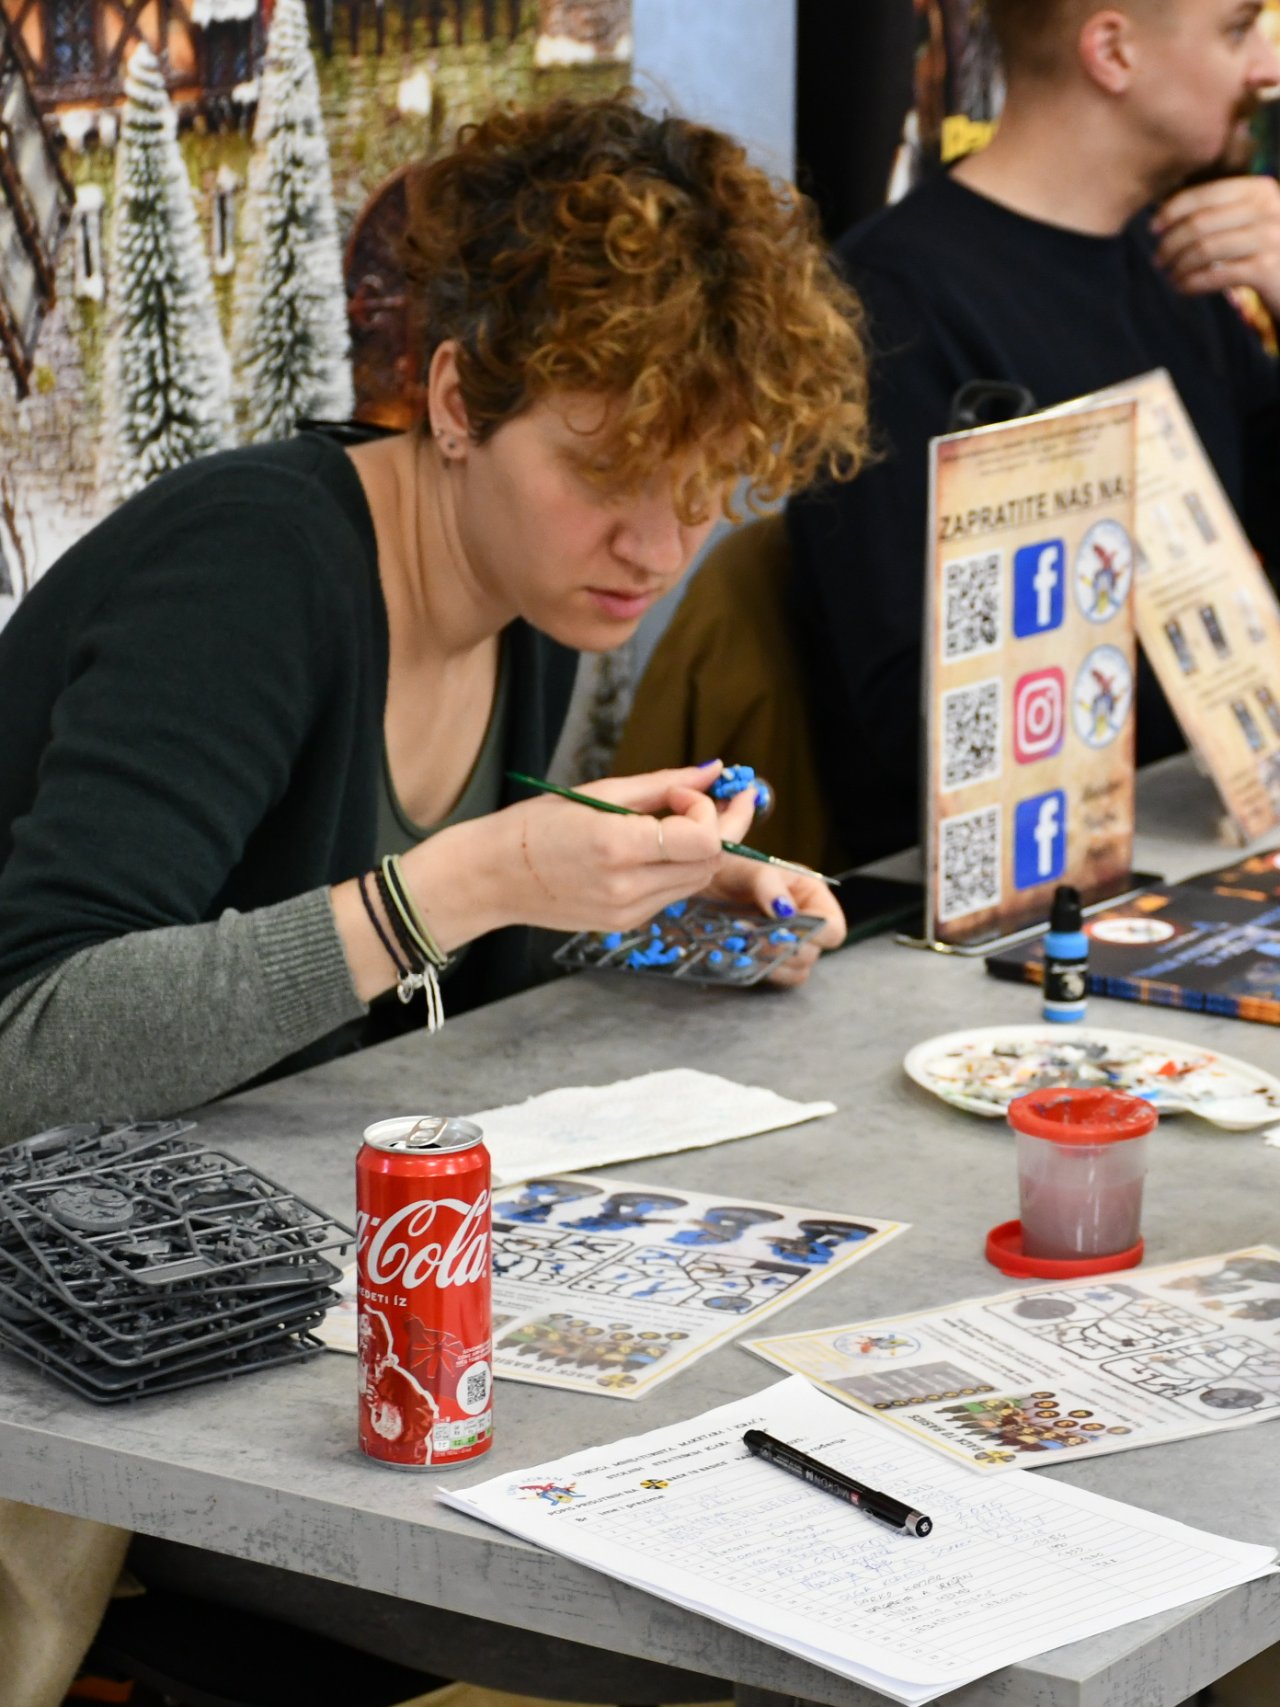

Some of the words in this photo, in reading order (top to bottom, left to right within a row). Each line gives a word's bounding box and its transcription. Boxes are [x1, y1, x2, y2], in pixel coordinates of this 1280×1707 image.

[938, 492, 1049, 541] ZAPRATITE
[1054, 481, 1094, 512] NAS
[358, 1285, 389, 1305] EDETI
